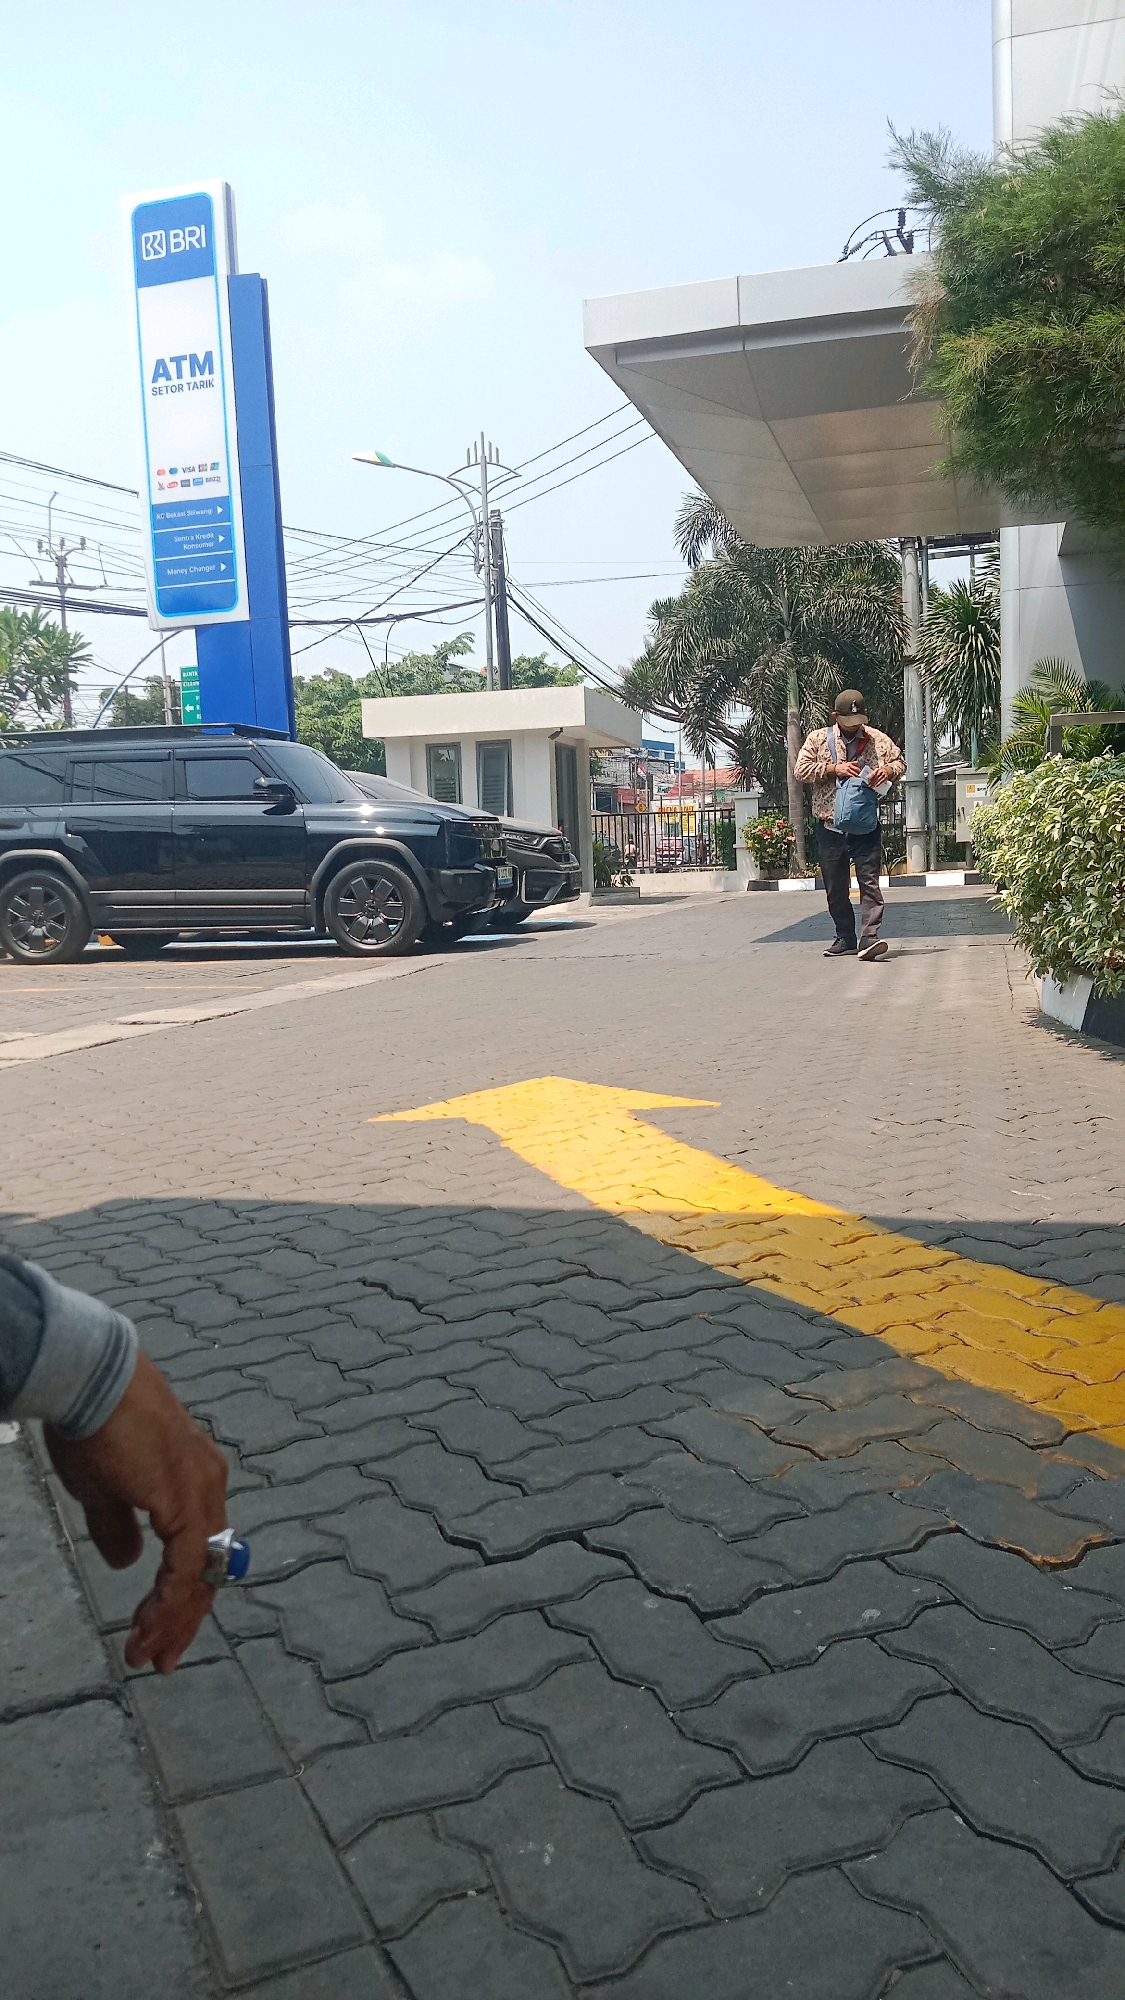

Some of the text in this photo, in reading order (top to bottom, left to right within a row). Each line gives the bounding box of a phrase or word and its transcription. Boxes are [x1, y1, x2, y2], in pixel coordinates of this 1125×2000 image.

[170, 225, 206, 254] BRI
[151, 351, 214, 384] ATM
[151, 378, 215, 397] SETOR TARIK
[182, 466, 196, 474] VISA
[156, 512, 165, 520] KC
[166, 510, 186, 519] Bekasi
[196, 532, 214, 540] Kredit
[184, 542, 213, 550] Konsumer
[167, 565, 216, 576] Money Changer
